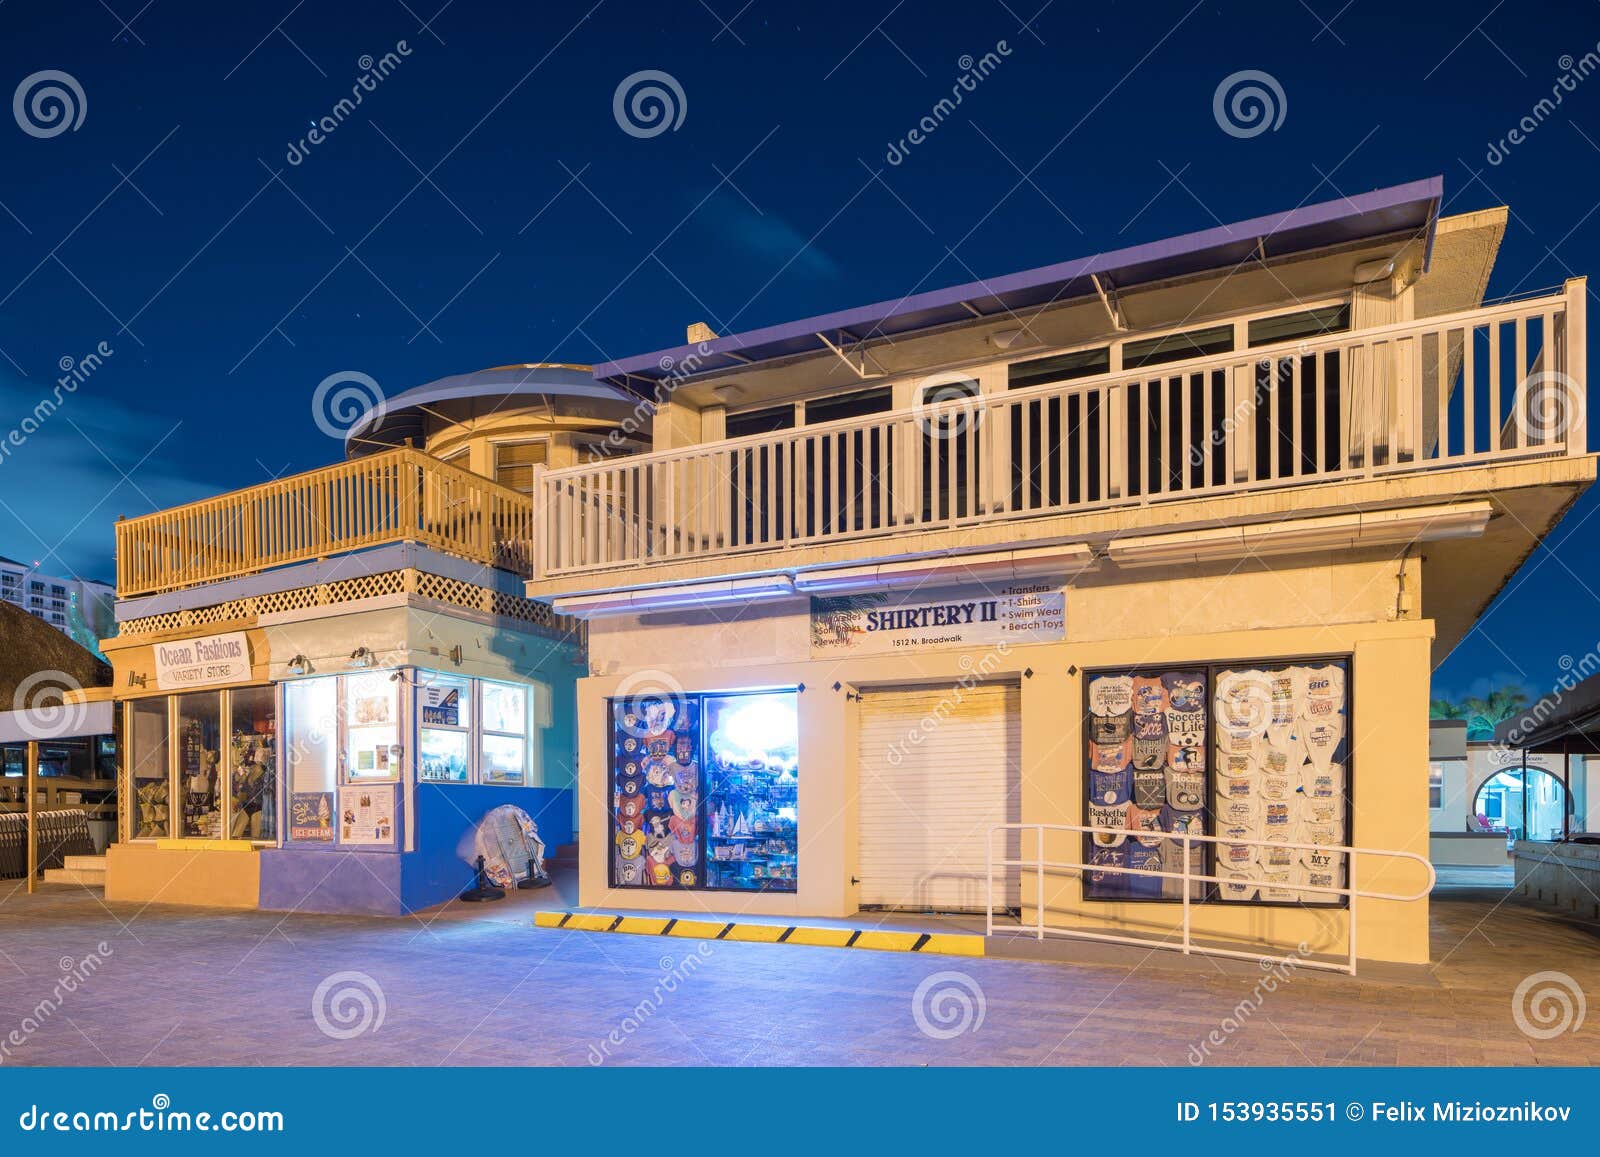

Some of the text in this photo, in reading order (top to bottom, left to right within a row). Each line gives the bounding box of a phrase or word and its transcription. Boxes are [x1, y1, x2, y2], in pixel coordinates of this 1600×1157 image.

[1007, 585, 1050, 595] Transfers
[1008, 597, 1042, 608] T-Shirts
[866, 601, 998, 632] SHIRTERY II
[1008, 608, 1062, 619] Swim Wear
[1008, 620, 1065, 631] Beach Toys
[892, 638, 909, 647] 1512
[921, 635, 963, 645] Broadwalk
[160, 637, 242, 667] Ocean Fashions
[172, 664, 232, 681] VARIETY STORE
[295, 828, 331, 838] ICE CREAM
